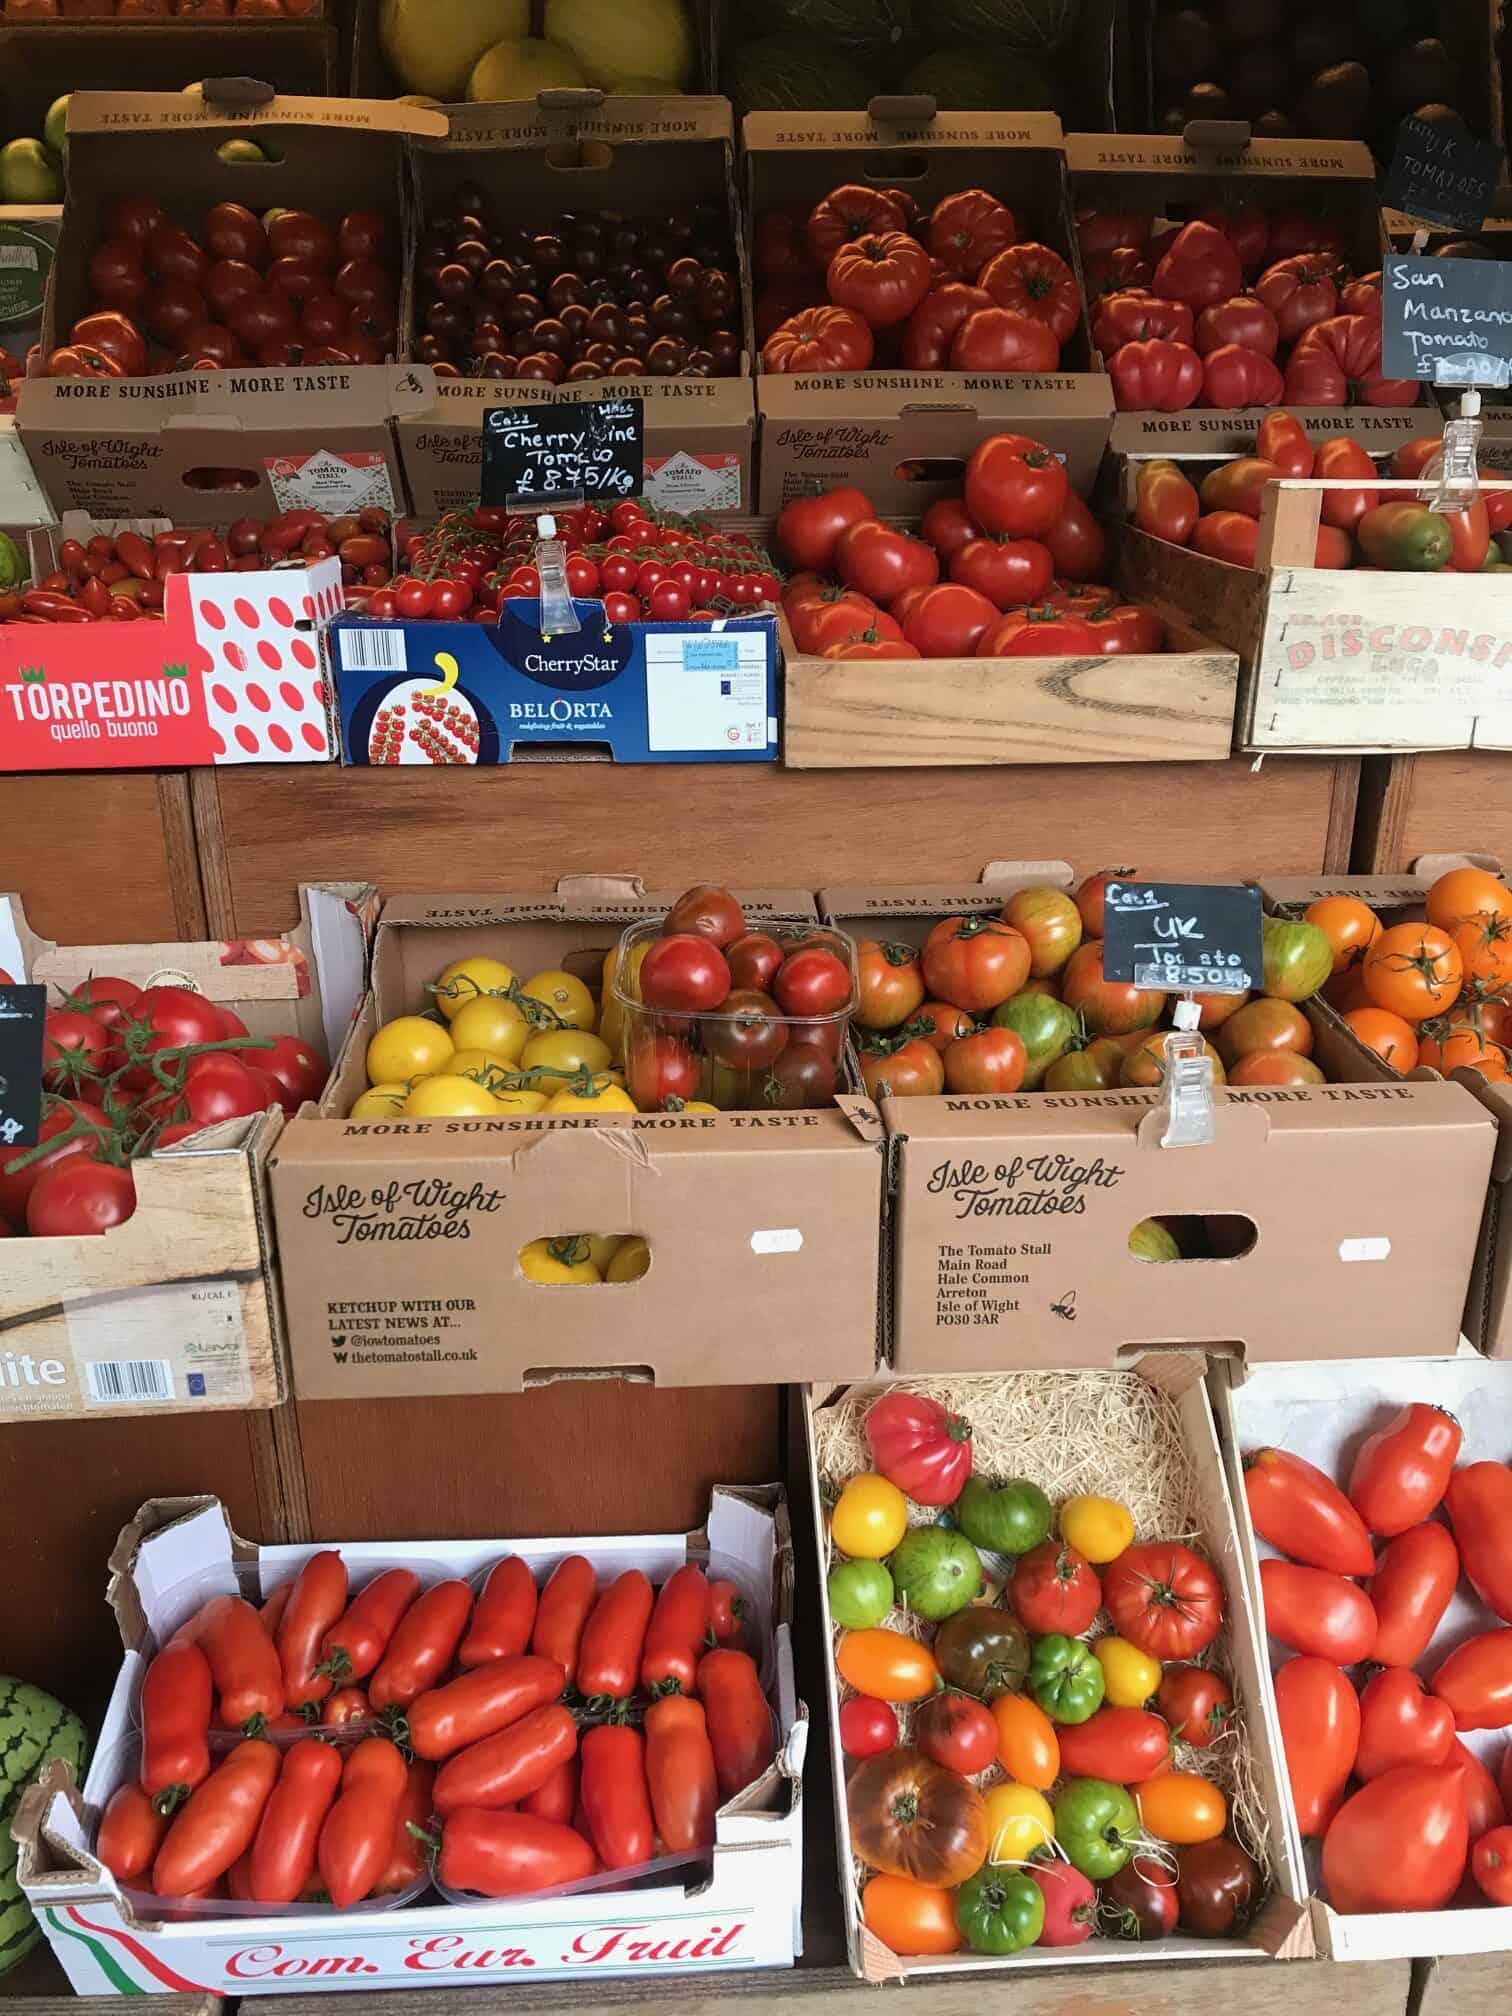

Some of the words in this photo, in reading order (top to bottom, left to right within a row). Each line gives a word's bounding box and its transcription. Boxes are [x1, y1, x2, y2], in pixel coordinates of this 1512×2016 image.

[100, 113, 152, 124] TASTE
[160, 112, 208, 123] MORE
[322, 112, 370, 124] MORE
[503, 127, 547, 139] MORE
[651, 120, 696, 132] MORE
[776, 132, 826, 143] TASTE
[832, 131, 879, 142] MORE
[984, 130, 1032, 141] MORE
[1098, 153, 1146, 163] TASTE
[1152, 154, 1196, 165] MORE
[1299, 157, 1343, 169] MORE
[1392, 264, 1444, 289] San
[1404, 299, 1512, 325] Manzano
[1402, 331, 1489, 356] Tomato
[56, 384, 111, 398] MORE
[119, 379, 210, 398] SUNSHINE
[230, 377, 285, 393] MORE
[293, 375, 351, 390] TASTE
[794, 379, 846, 390] MORE
[853, 377, 944, 390] SUNSHINE
[964, 378, 1015, 390] MORE
[1021, 379, 1076, 390] TASTE
[436, 385, 486, 398] MORE
[494, 387, 583, 404] SUNSHINE
[602, 384, 653, 398] MORE
[661, 384, 716, 397] TASTE
[1142, 420, 1192, 433] MORE
[1199, 419, 1263, 432] SUNSHI
[1305, 417, 1354, 430] MORE
[1360, 417, 1413, 430] TASTE
[504, 431, 586, 450] Cherry
[776, 428, 813, 446] Isle
[816, 427, 833, 444] of
[834, 426, 894, 448] Wight
[41, 440, 80, 456] Isle
[100, 439, 165, 458] Wight
[432, 448, 482, 464] Toma
[792, 443, 870, 459] Tomatoes
[62, 454, 149, 470] Tomatoes
[525, 654, 619, 675] CherryStar
[5, 678, 190, 720] TORPEDINO
[510, 699, 613, 721] BELORTA
[51, 720, 100, 743] quello
[106, 719, 158, 737] buono
[942, 896, 1004, 906] MORE
[1309, 890, 1377, 898] TASTE
[1384, 890, 1430, 898] ORE
[503, 904, 566, 915] MORE
[591, 905, 673, 915] NSHINE
[741, 903, 774, 912] MO
[865, 899, 932, 908] TASTE
[425, 908, 493, 918] TASTE
[1154, 916, 1205, 939] UK
[945, 1097, 1032, 1112] MORE
[1043, 1093, 1160, 1109] SUNSHI
[1226, 1089, 1312, 1103] MORE
[1322, 1087, 1415, 1101] TASTE
[344, 1123, 433, 1136] MORE
[445, 1119, 600, 1133] SUNSHINE
[631, 1117, 716, 1130] MORE
[728, 1115, 819, 1128] TASTE
[926, 1159, 990, 1193] Isle
[994, 1156, 1025, 1189] of
[1026, 1154, 1126, 1195] Wight
[302, 1184, 367, 1218] Isle
[371, 1181, 402, 1213] of
[402, 1178, 507, 1220] Wight
[953, 1188, 1087, 1219] Tomatoes
[332, 1212, 471, 1244] Tomatoes
[938, 1245, 964, 1257] The
[967, 1244, 1017, 1256] Tomato
[1020, 1243, 1052, 1255] Stall
[938, 1259, 971, 1271] Main
[975, 1258, 1007, 1270] Road
[937, 1273, 968, 1285] Hale
[972, 1272, 1029, 1284] Common
[936, 1287, 988, 1299] Arreton
[327, 1301, 397, 1314] KETCHUP
[401, 1299, 442, 1313] WITH
[445, 1299, 476, 1312] OUR
[936, 1301, 961, 1313] Isle
[964, 1300, 980, 1312] of
[981, 1299, 1020, 1314] Wight
[328, 1318, 381, 1331] LATEST
[385, 1316, 429, 1330] NEWS
[432, 1316, 461, 1329] AT...
[936, 1314, 970, 1326] PO30
[973, 1313, 1000, 1325] 3AR
[350, 1334, 441, 1347] @iowtomatoes
[351, 1348, 478, 1364] thetomatostall.co.uk
[0, 1351, 66, 1385] ite
[224, 1945, 379, 1979] Com.
[404, 1935, 536, 1971] Eur.
